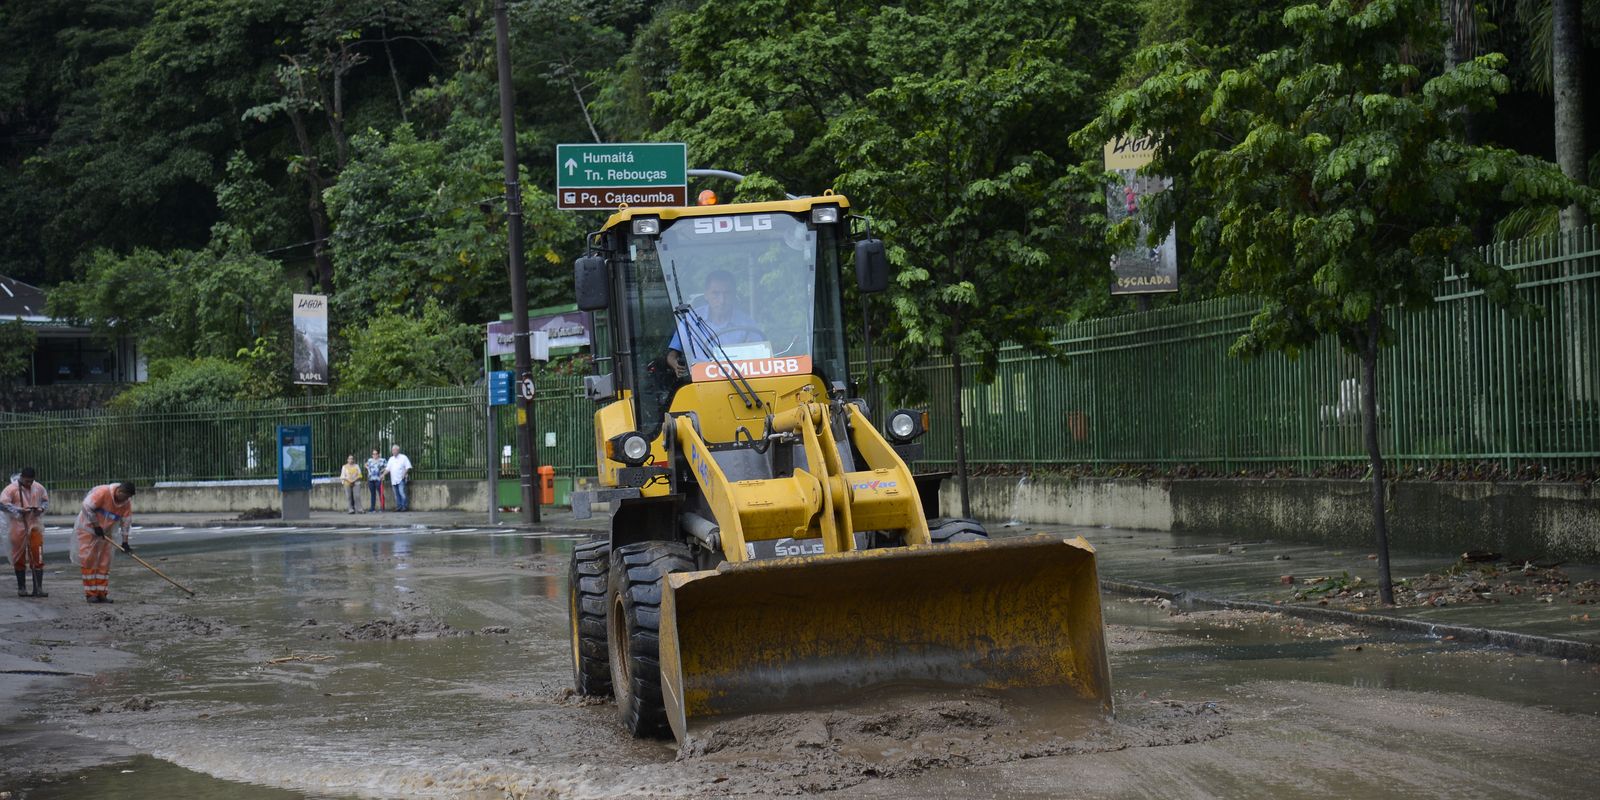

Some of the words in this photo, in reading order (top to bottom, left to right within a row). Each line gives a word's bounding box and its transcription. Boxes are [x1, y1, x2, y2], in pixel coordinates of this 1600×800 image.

[583, 151, 634, 163] Humaitá
[584, 170, 604, 180] Tn.
[607, 169, 667, 182] Rebouças
[581, 193, 601, 206] Pq.
[605, 192, 674, 203] Catacumba
[694, 214, 772, 234] SDLG
[1117, 275, 1171, 287] ESCALADA
[298, 299, 322, 308] LAGOA
[705, 359, 799, 378] COMLURB
[300, 372, 321, 381] RAPEL
[775, 543, 824, 557] SDLG
